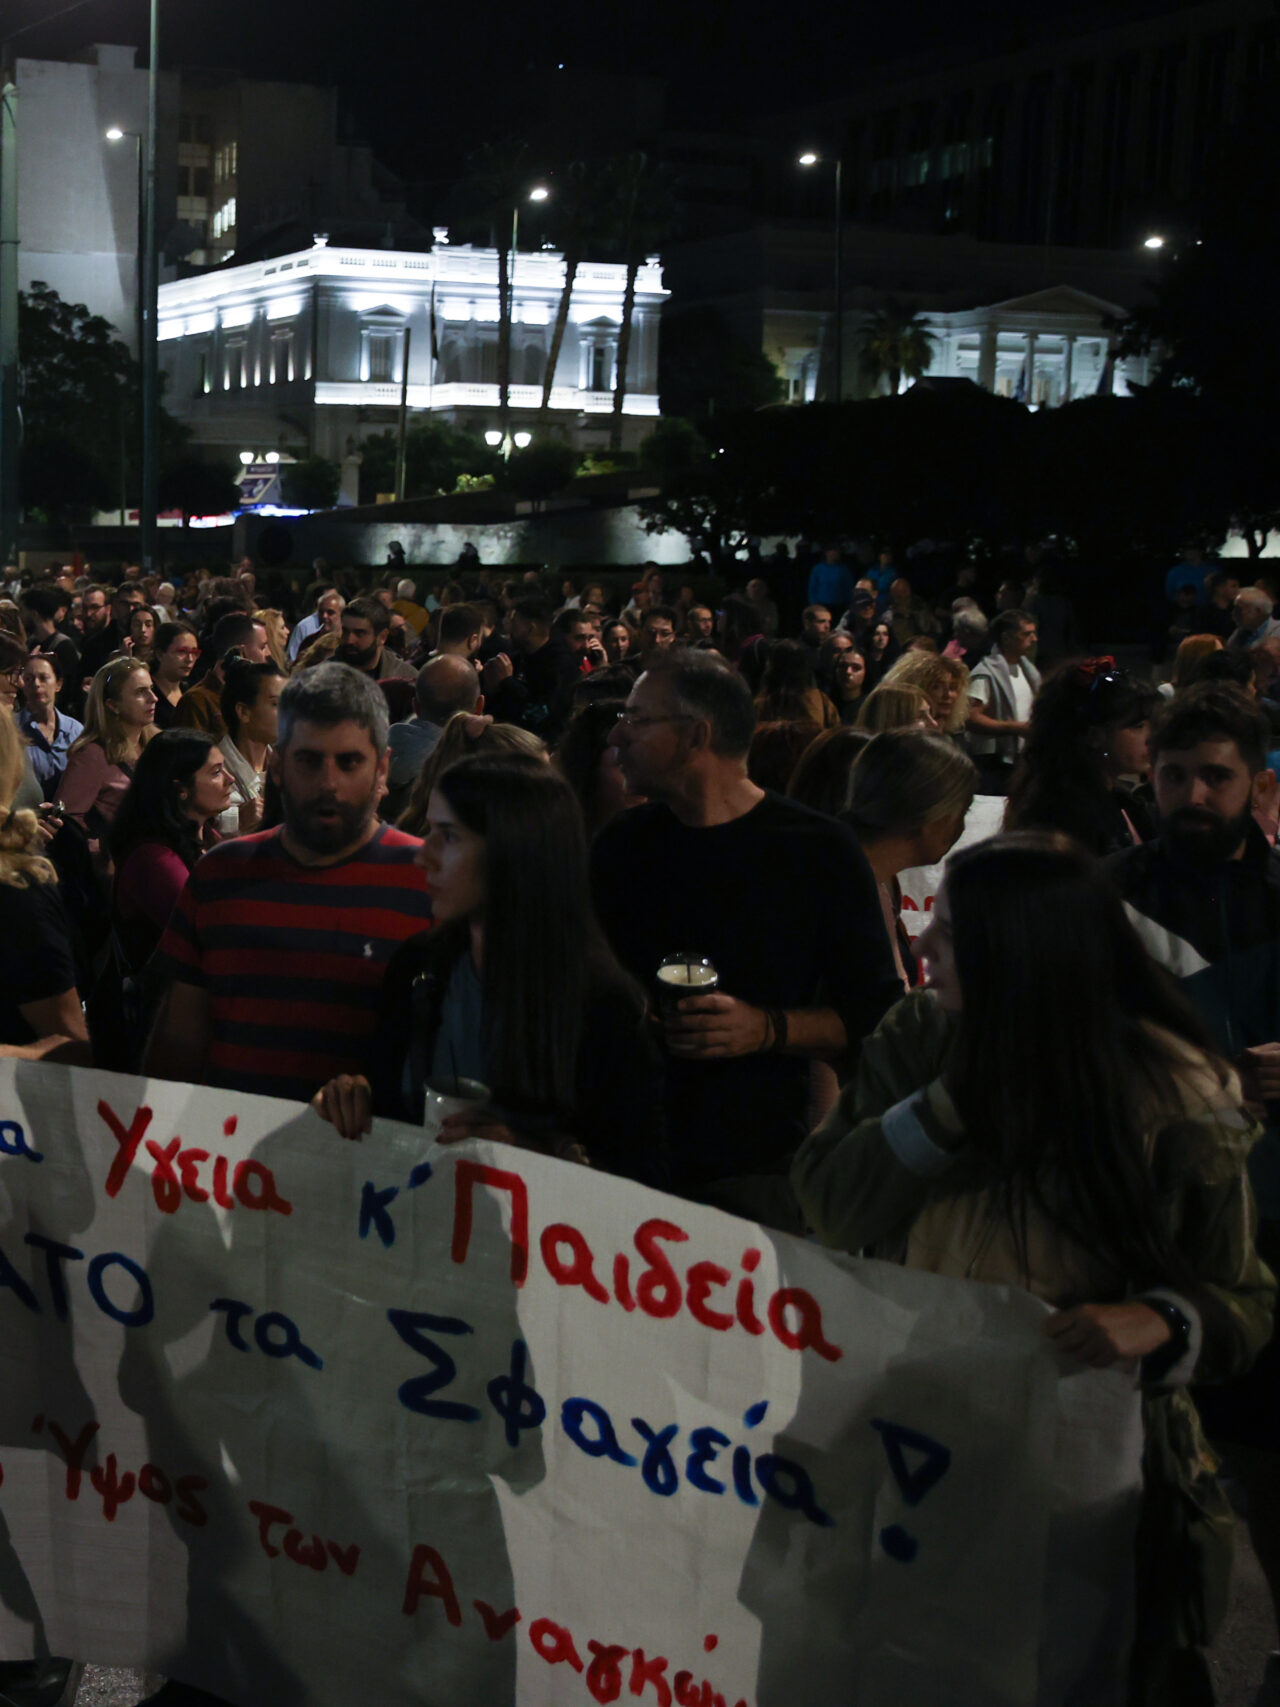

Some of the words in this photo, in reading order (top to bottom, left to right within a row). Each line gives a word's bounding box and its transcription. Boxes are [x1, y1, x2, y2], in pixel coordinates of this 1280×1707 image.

[97, 1100, 293, 1214] Υγεία
[450, 1158, 844, 1364] Παιδεία
[210, 1298, 324, 1370] τα
[248, 1500, 362, 1576] των
[402, 1544, 748, 1707] Αναγκώ
